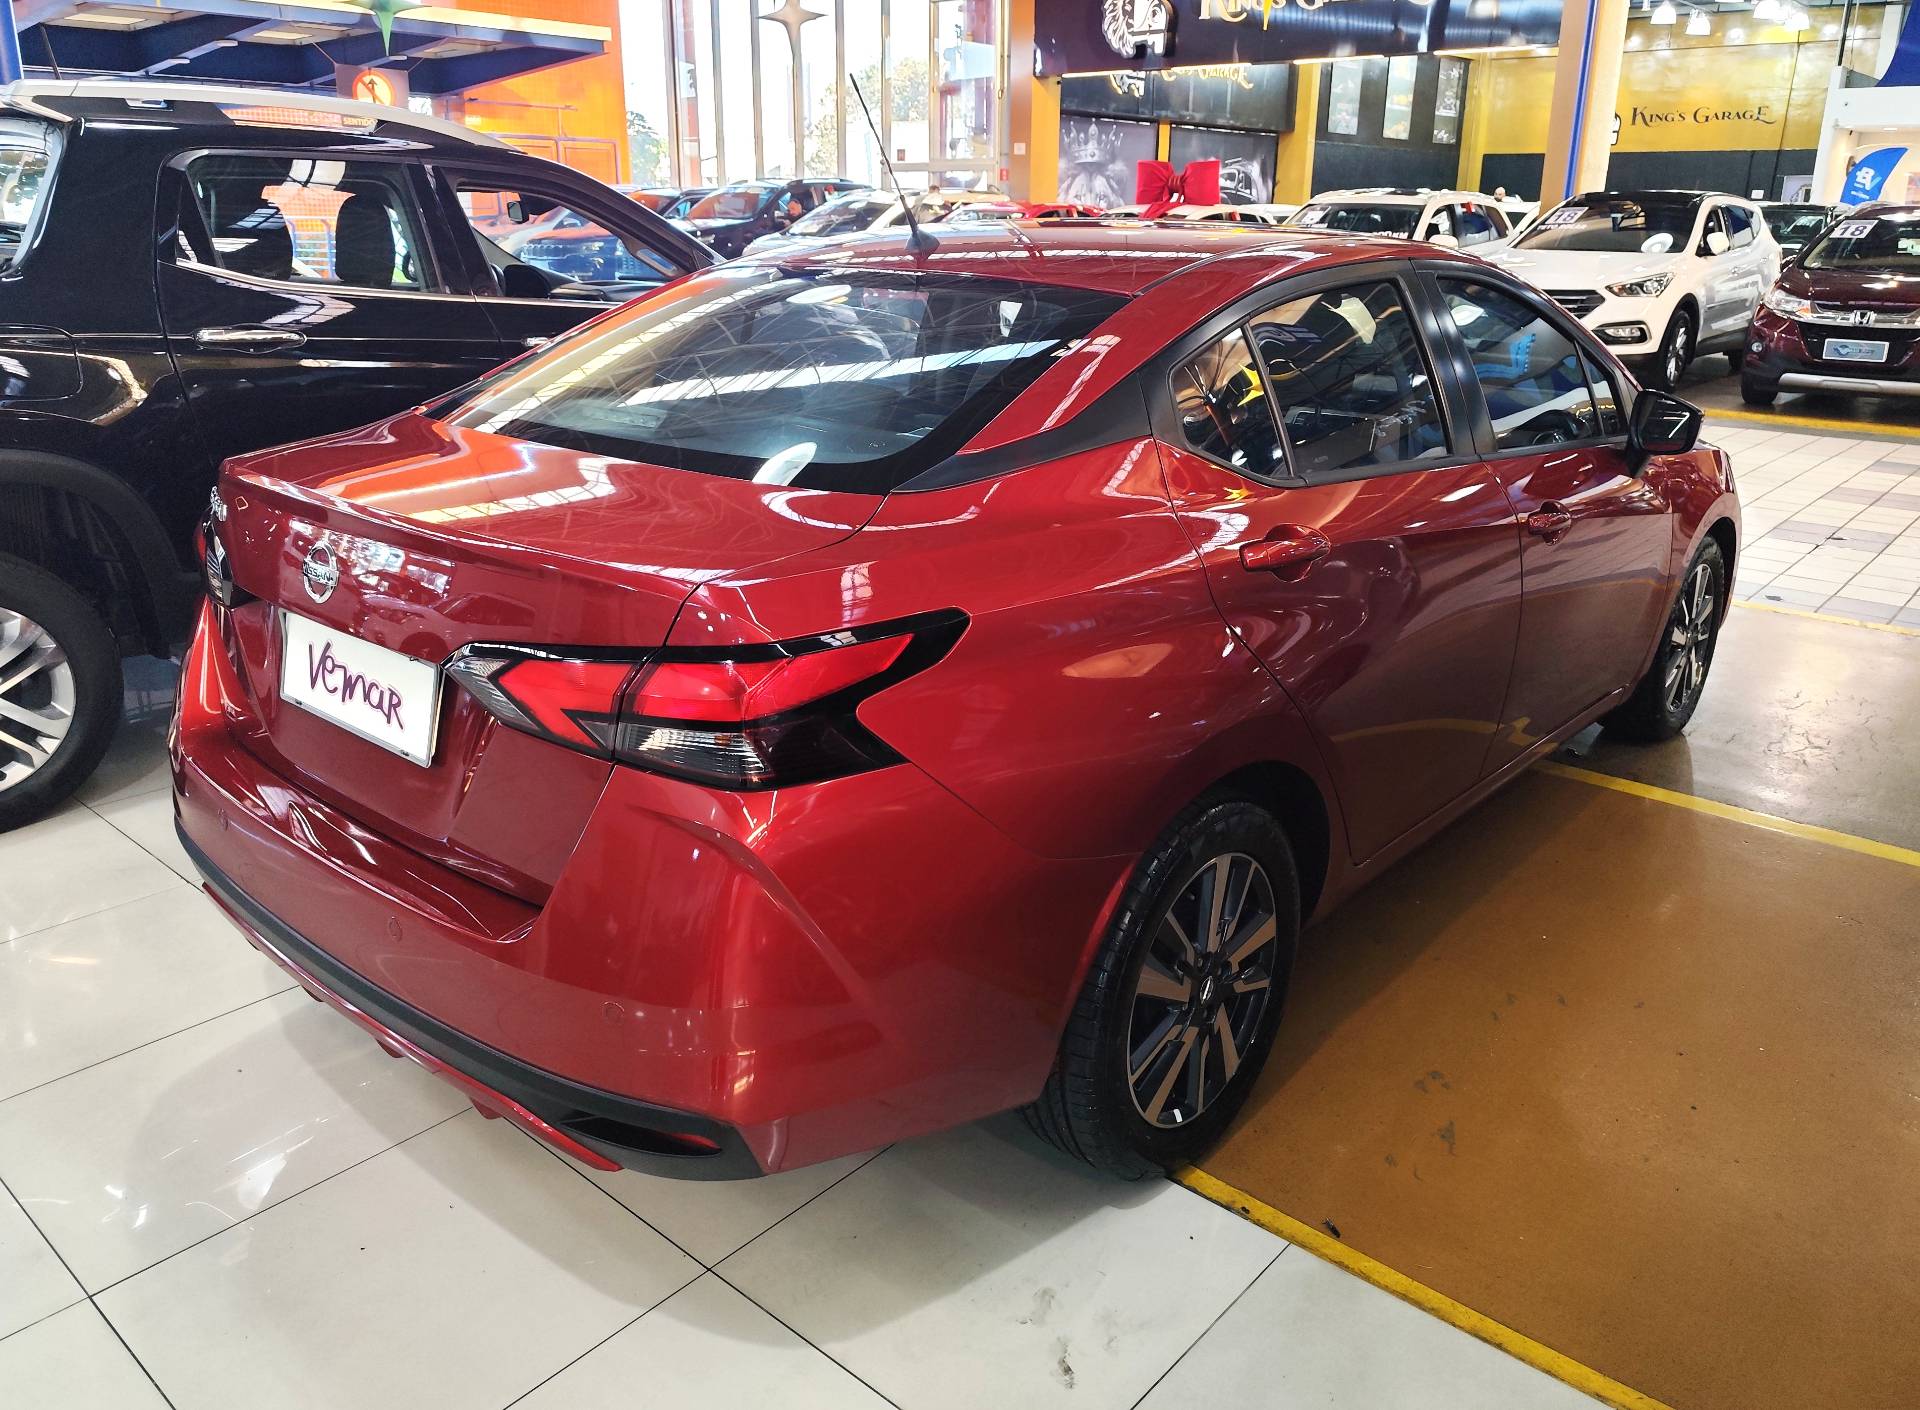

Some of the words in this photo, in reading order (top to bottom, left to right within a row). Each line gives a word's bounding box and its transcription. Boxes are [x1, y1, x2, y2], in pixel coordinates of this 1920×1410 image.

[1631, 105, 1686, 127] KING'S
[1693, 105, 1777, 125] GARAGE
[1839, 225, 1867, 237] 18
[303, 560, 333, 582] NISSAN
